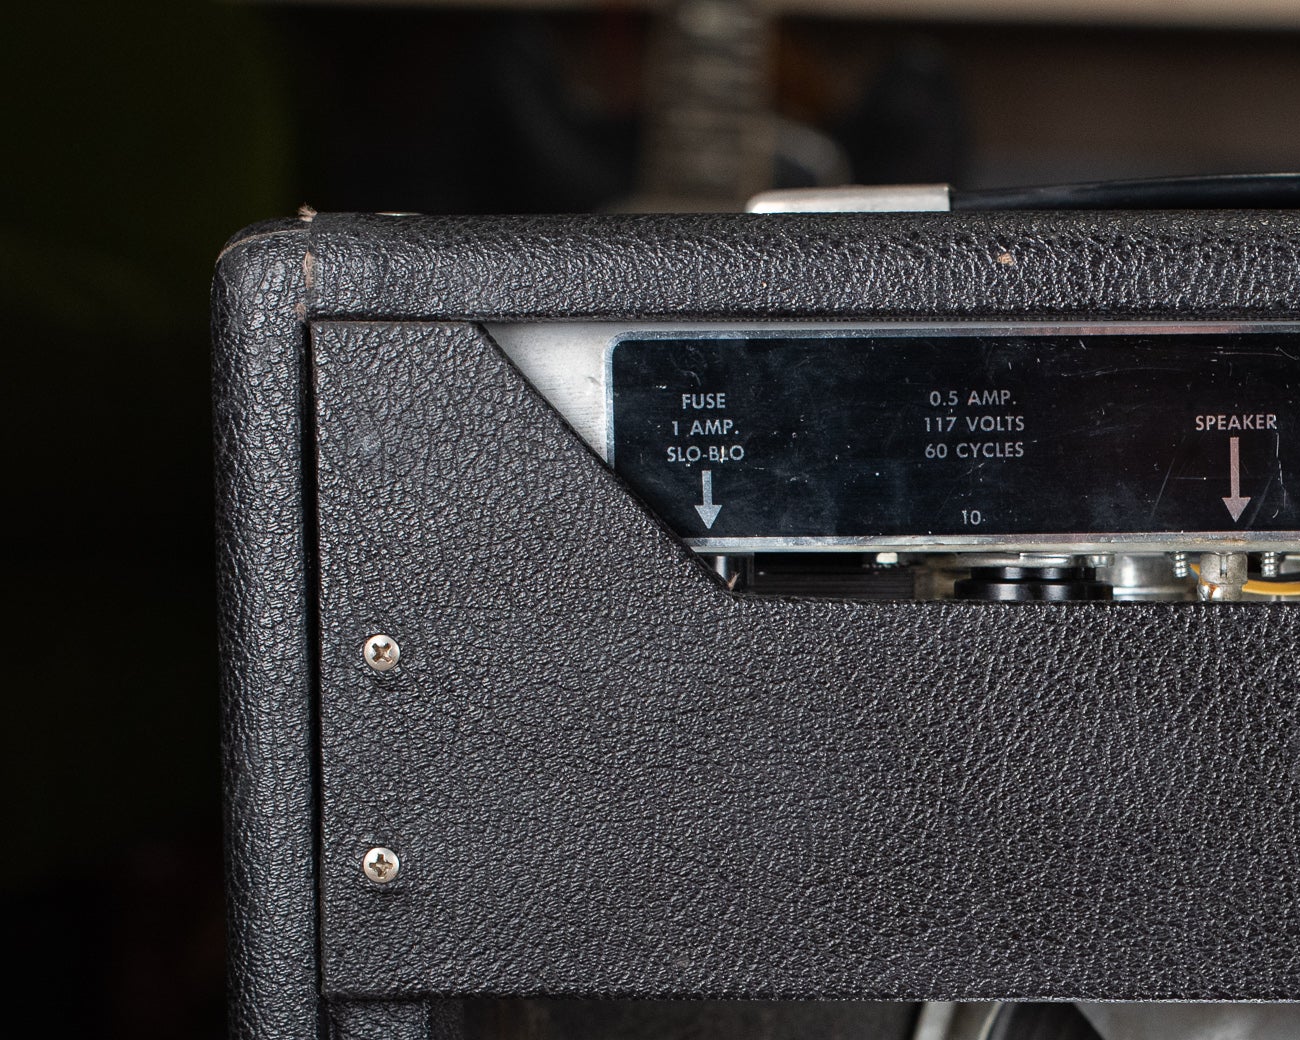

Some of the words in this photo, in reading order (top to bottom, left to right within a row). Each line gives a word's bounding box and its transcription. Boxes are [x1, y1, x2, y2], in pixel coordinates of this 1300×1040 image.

[682, 393, 726, 409] FUSE
[929, 390, 959, 406] 0.5
[967, 390, 1017, 406] AMP.
[672, 421, 678, 435] 1
[690, 420, 739, 435] AMP.
[925, 417, 956, 432] 117
[966, 416, 1025, 431] VOLTS
[1195, 414, 1277, 431] SPEAKER
[666, 446, 745, 461] SLO-BLO
[925, 443, 948, 458] 60
[957, 442, 1024, 457] CYCLES
[962, 510, 981, 525] 10
